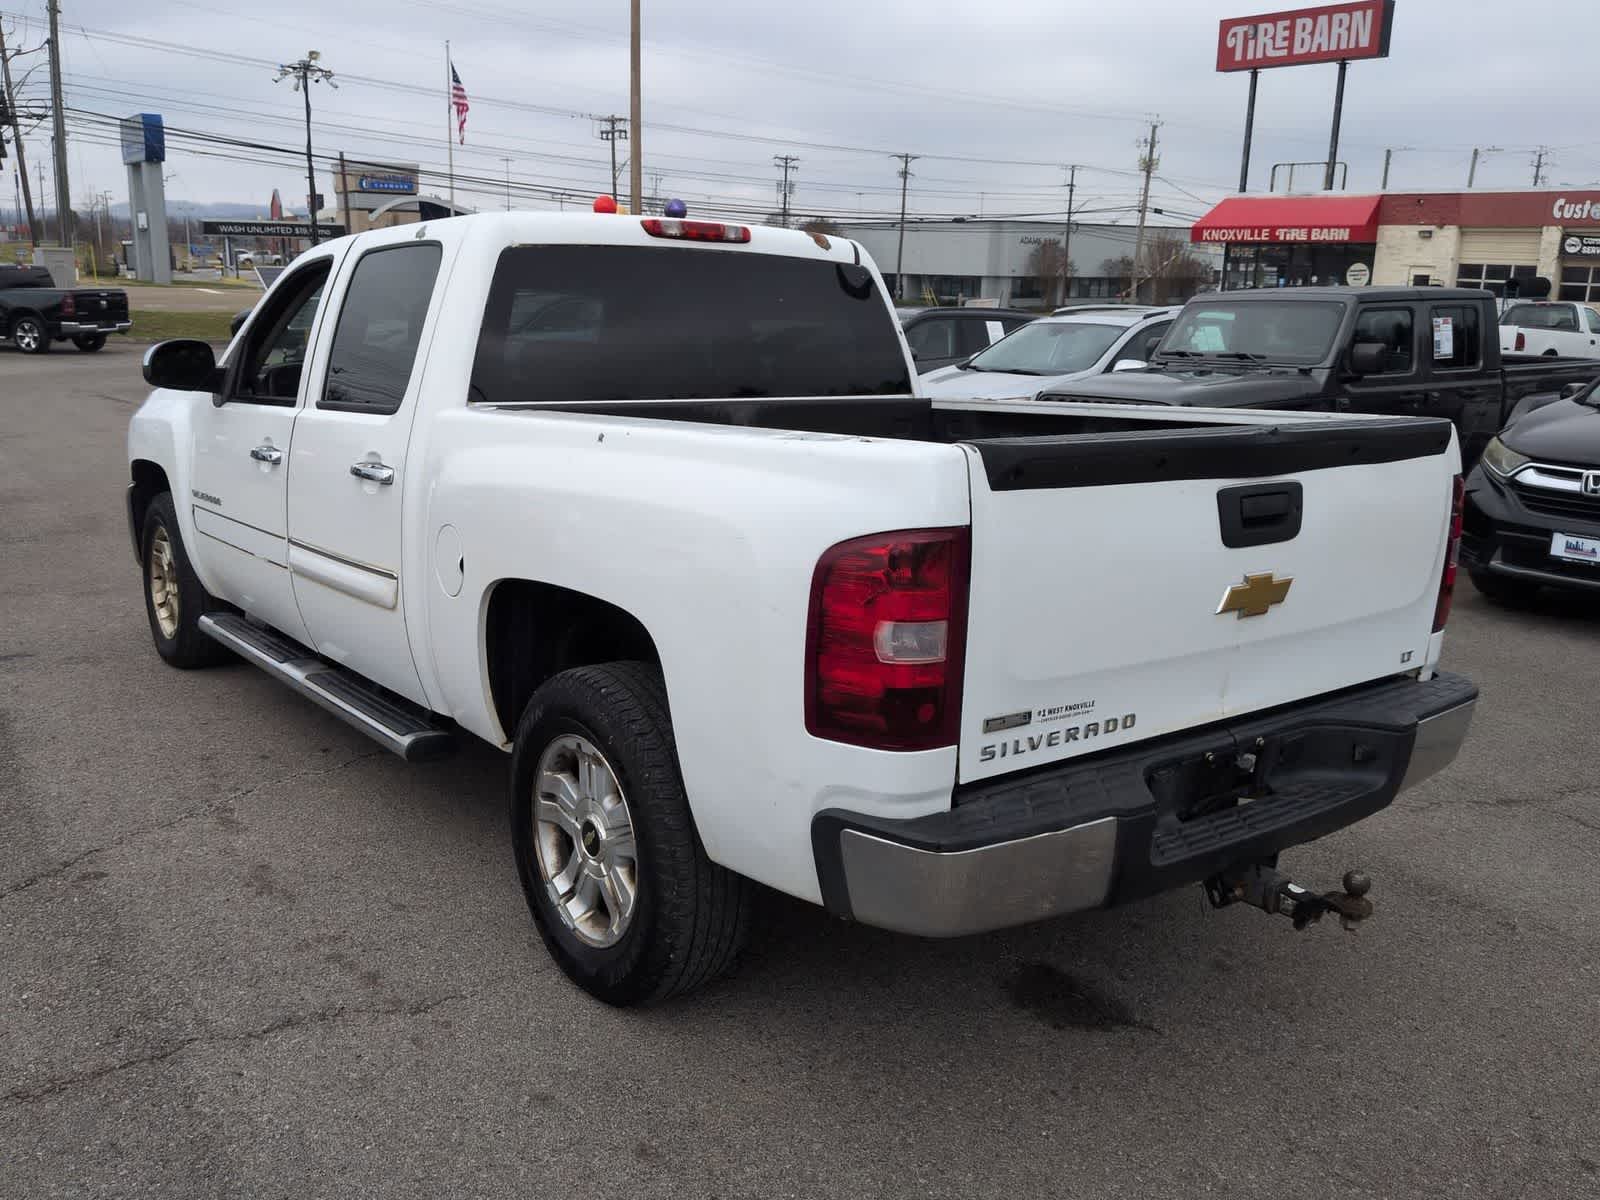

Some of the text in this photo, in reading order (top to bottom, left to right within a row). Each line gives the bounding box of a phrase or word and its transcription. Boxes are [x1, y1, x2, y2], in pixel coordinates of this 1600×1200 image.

[1293, 9, 1373, 55] BARN
[219, 225, 245, 233] WASH
[247, 226, 293, 234] UNLIMITED
[1202, 228, 1270, 241] KNOXVILLE
[1310, 228, 1350, 241] BARN
[1400, 650, 1414, 663] LT
[1047, 706, 1064, 716] WEST
[1065, 700, 1095, 712] KNOXVILLE
[979, 713, 1137, 762] SILVERADO
